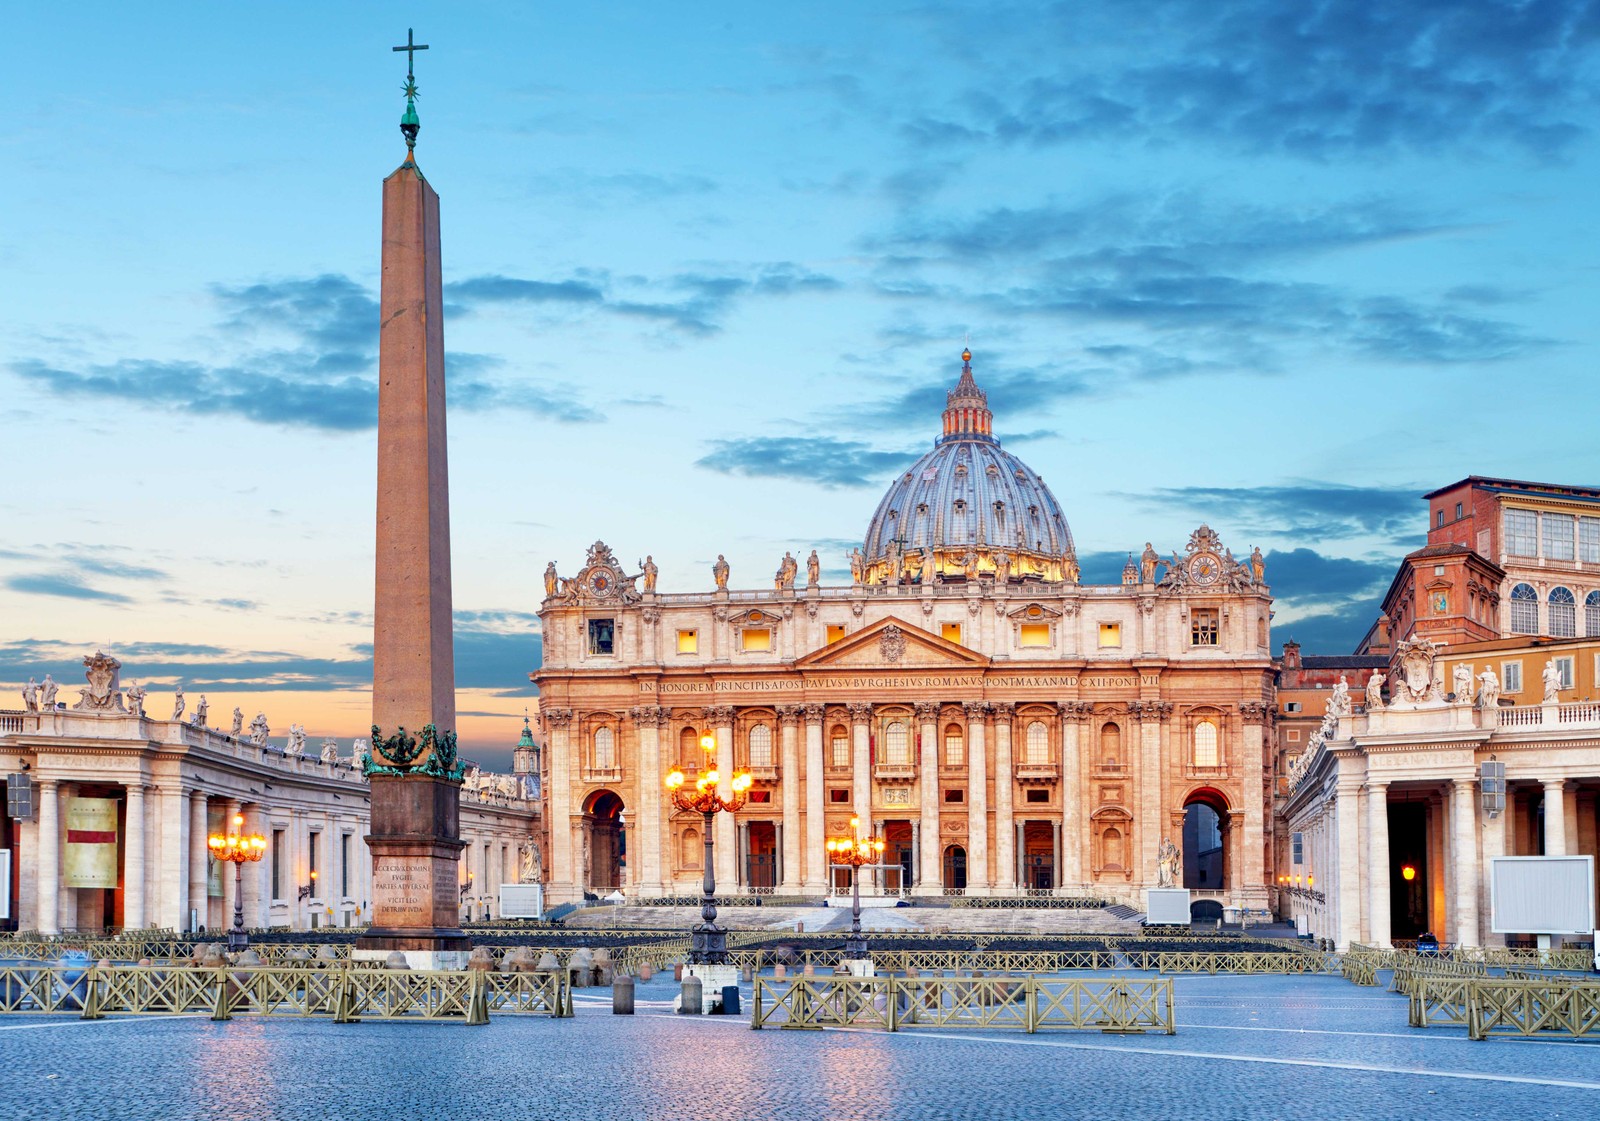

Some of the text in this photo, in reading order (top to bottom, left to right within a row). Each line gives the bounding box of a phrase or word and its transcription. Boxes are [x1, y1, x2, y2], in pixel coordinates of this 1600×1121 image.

[640, 682, 653, 692] IN
[659, 683, 714, 692] HONOREM
[715, 681, 770, 690] PRINCIPIS
[925, 677, 983, 687] ROMANVS
[1142, 676, 1158, 685] VII
